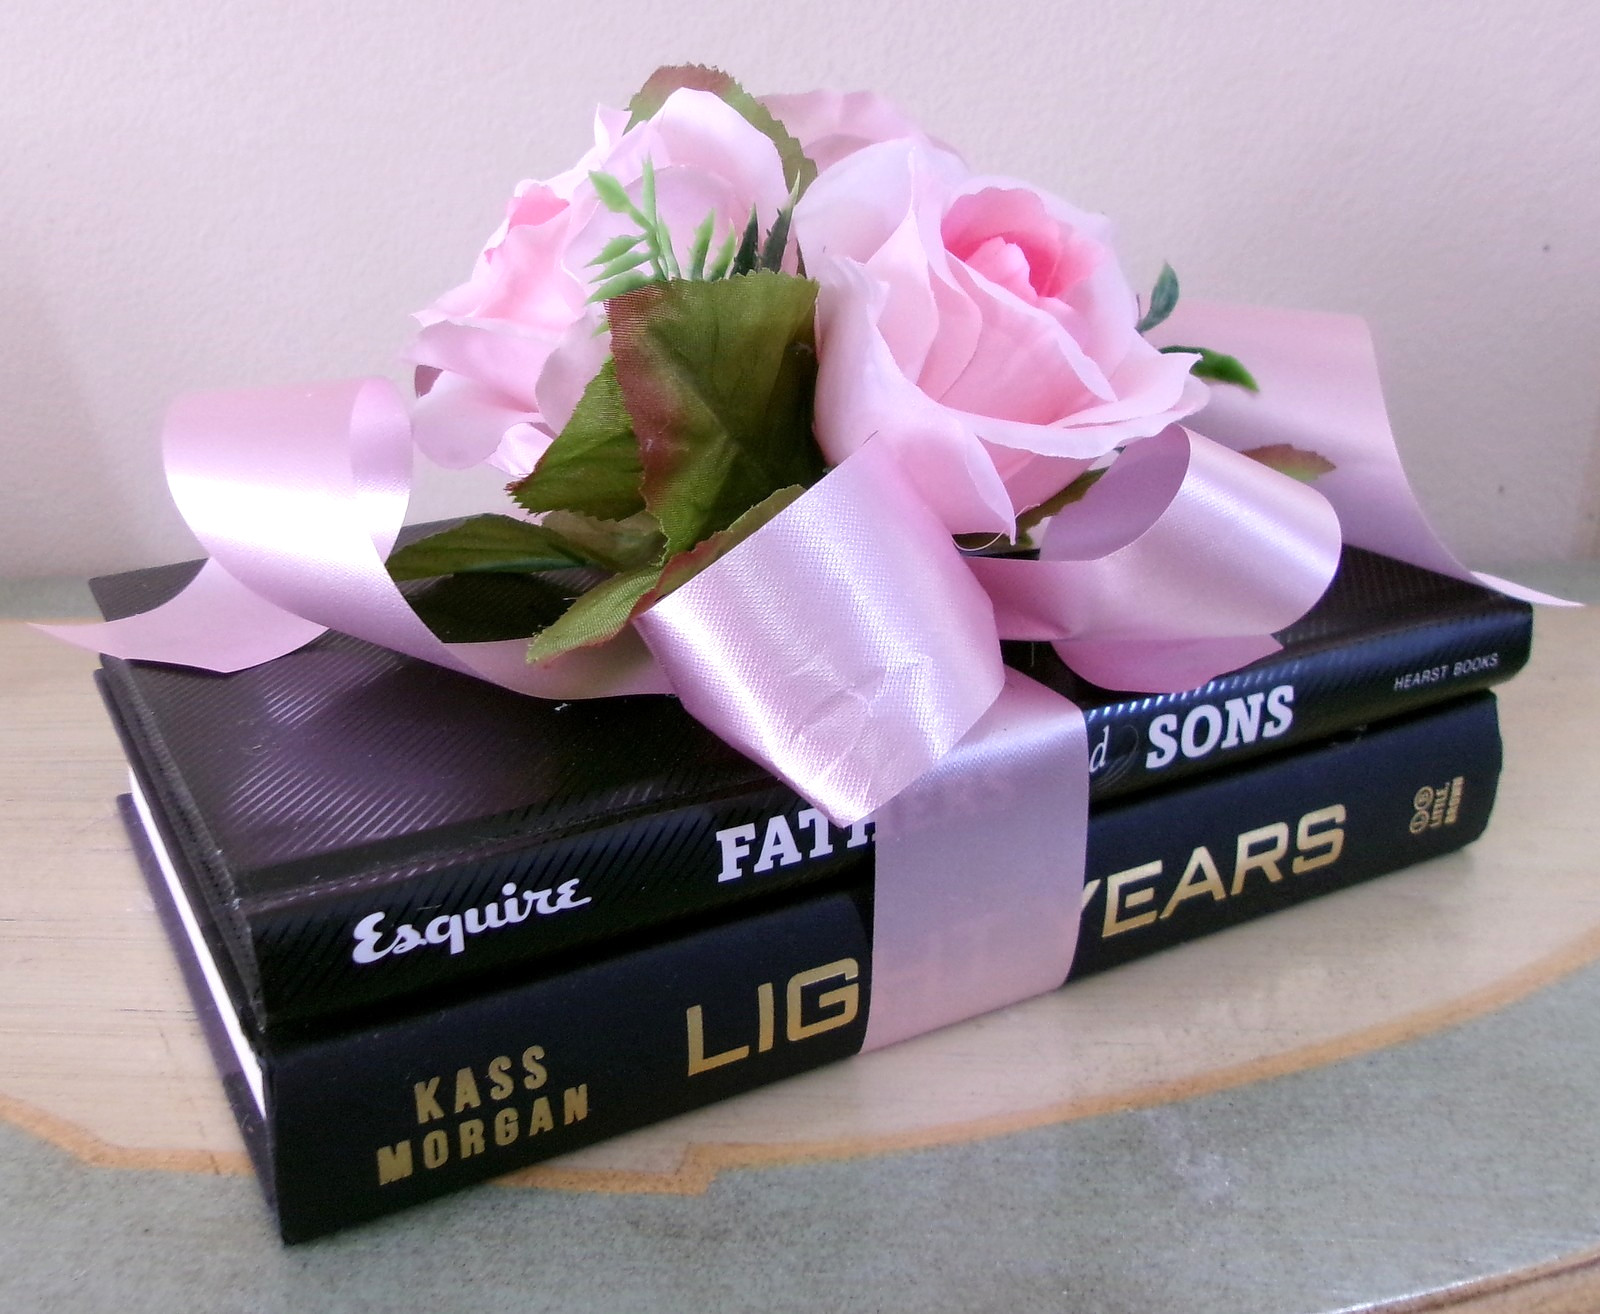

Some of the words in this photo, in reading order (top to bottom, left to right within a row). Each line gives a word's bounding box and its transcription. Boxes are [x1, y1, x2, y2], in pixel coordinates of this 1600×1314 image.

[1394, 664, 1449, 691] HEARST
[1453, 652, 1499, 677] BOOKS
[1145, 684, 1295, 769] SONS
[352, 879, 592, 965] Esquire
[414, 1044, 548, 1124] KASS
[377, 1083, 589, 1186] MORGAN
